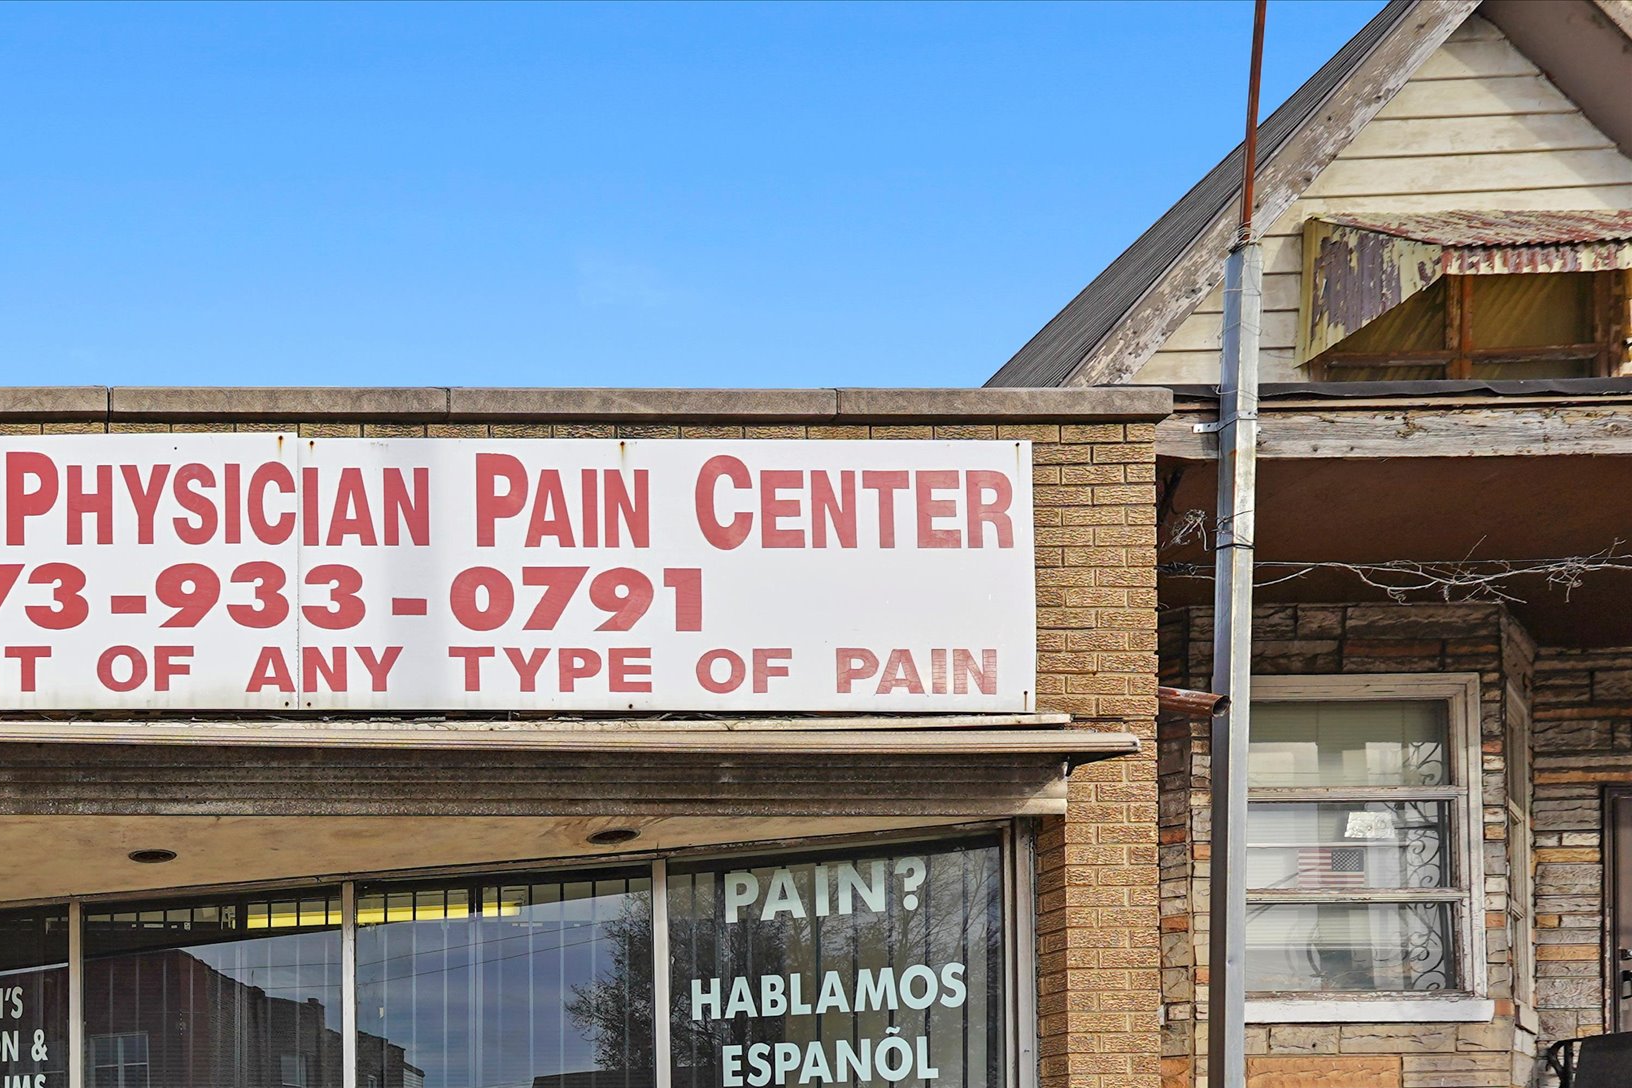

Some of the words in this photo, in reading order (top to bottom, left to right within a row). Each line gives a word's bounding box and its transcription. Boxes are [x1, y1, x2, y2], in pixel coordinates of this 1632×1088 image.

[6, 451, 429, 548] PHYSICIAN
[475, 452, 650, 548] PAIN
[695, 454, 1014, 550] CENTER
[97, 645, 194, 692] OF
[245, 646, 403, 692] ANY
[449, 647, 652, 693] TYPE
[695, 648, 791, 694] OF
[835, 648, 998, 694] PAIN
[724, 856, 927, 923] PAIN?
[691, 962, 967, 1021] HABLAMOS
[31, 1028, 48, 1061] &
